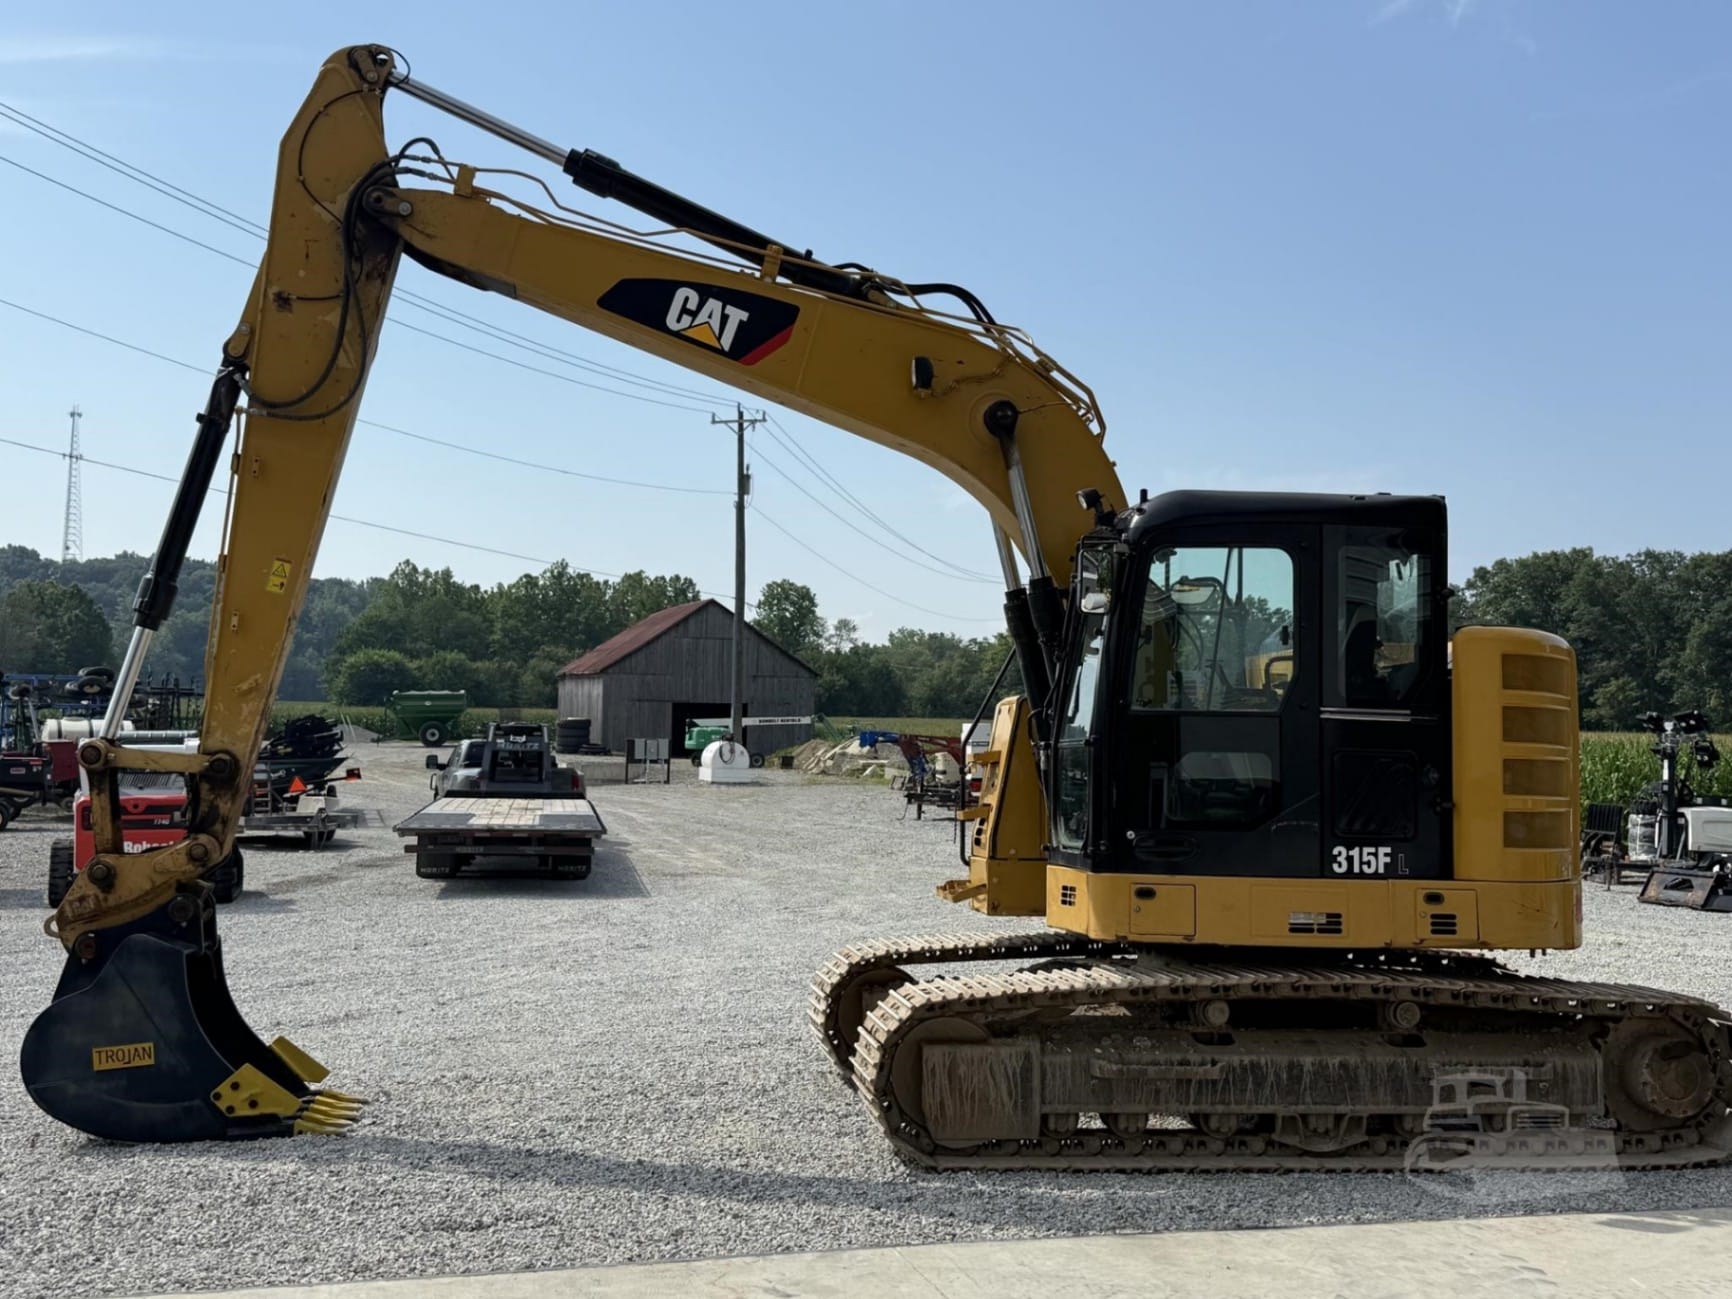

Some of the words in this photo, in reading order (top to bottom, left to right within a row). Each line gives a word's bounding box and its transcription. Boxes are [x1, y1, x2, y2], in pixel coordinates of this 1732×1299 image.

[665, 287, 750, 352] CAT
[123, 841, 175, 854] Bob
[1332, 845, 1391, 874] 315F
[1398, 853, 1409, 875] L
[95, 1046, 152, 1065] TROJAN
